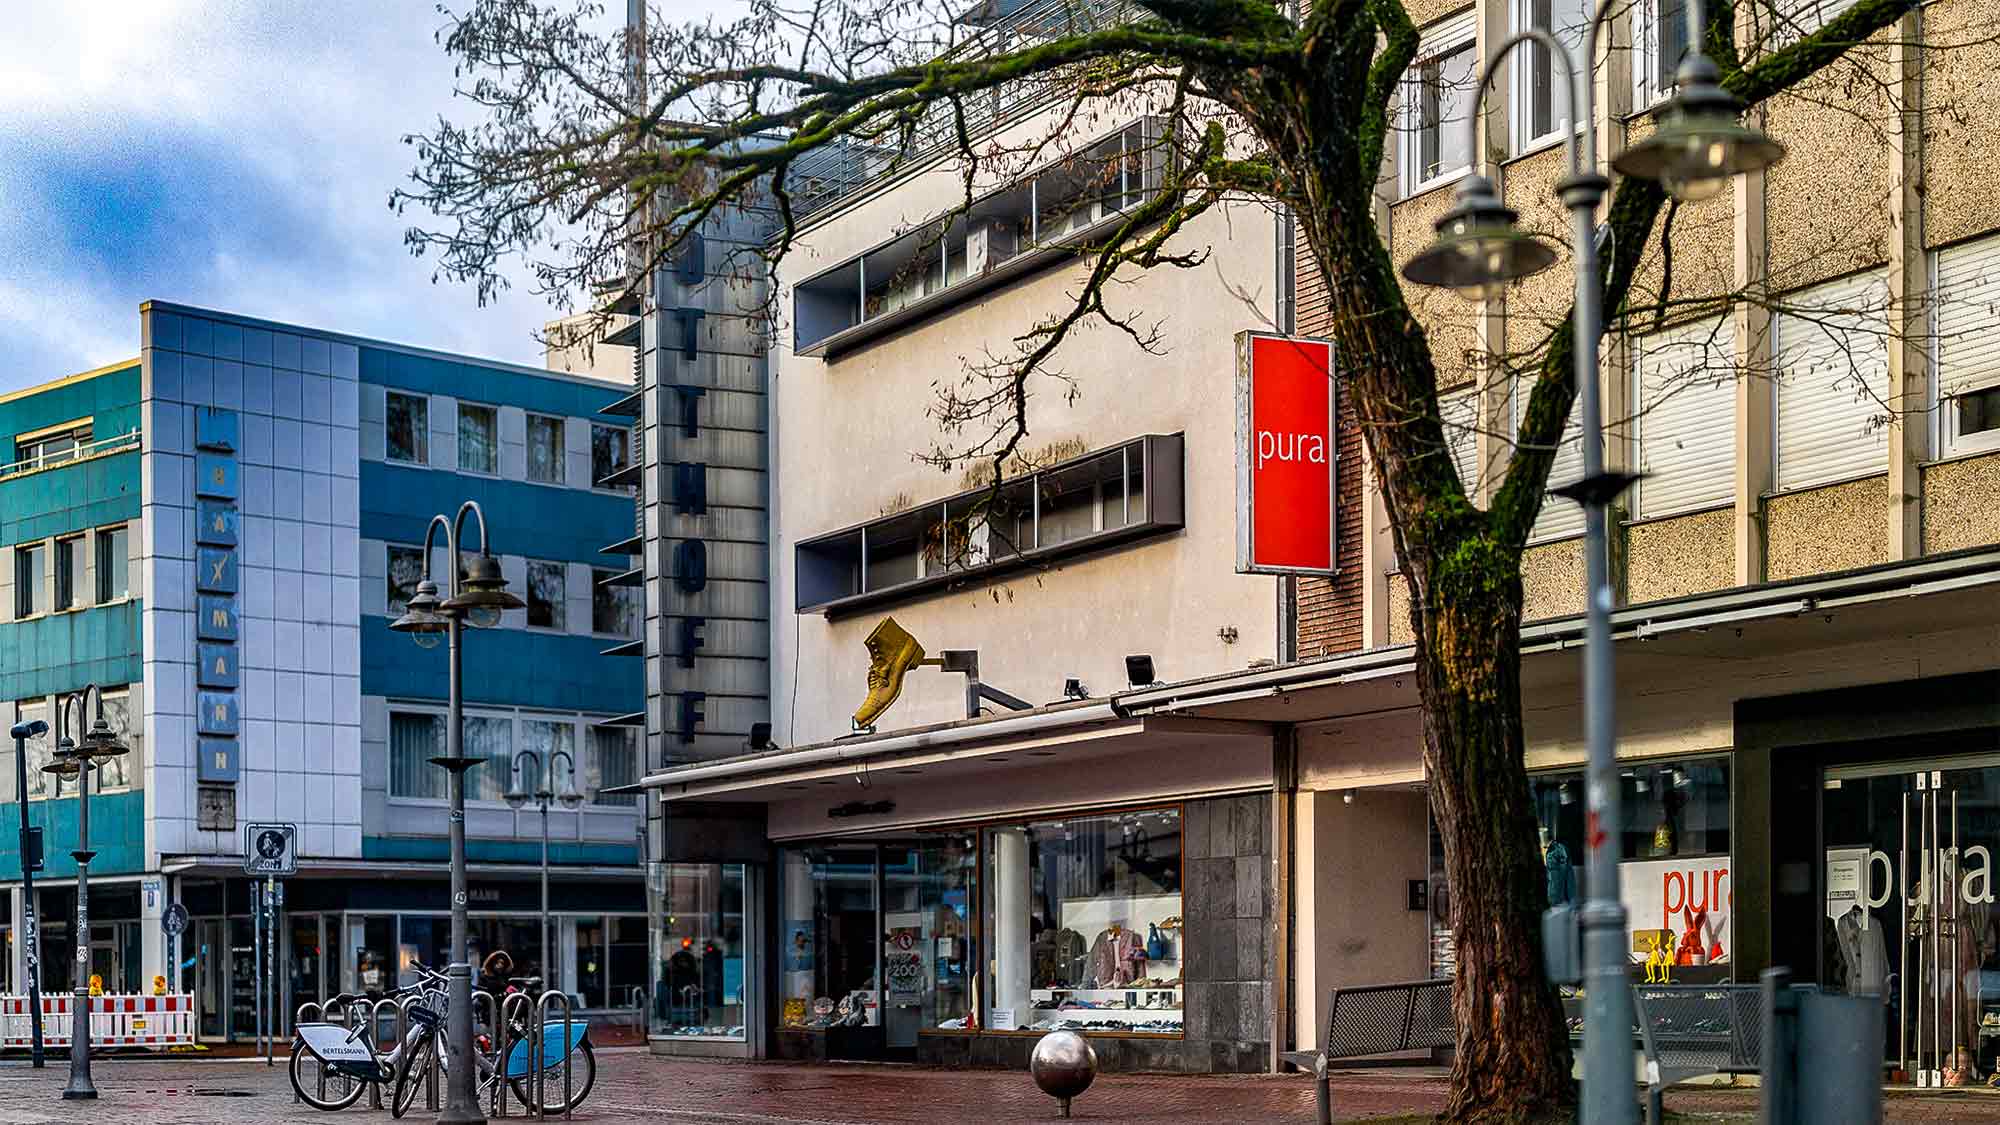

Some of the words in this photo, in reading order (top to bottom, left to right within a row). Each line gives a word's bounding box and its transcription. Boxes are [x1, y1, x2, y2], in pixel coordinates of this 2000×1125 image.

[1258, 430, 1326, 470] pura
[1663, 868, 1730, 930] pur
[322, 1047, 366, 1055] BERTELSMANN
